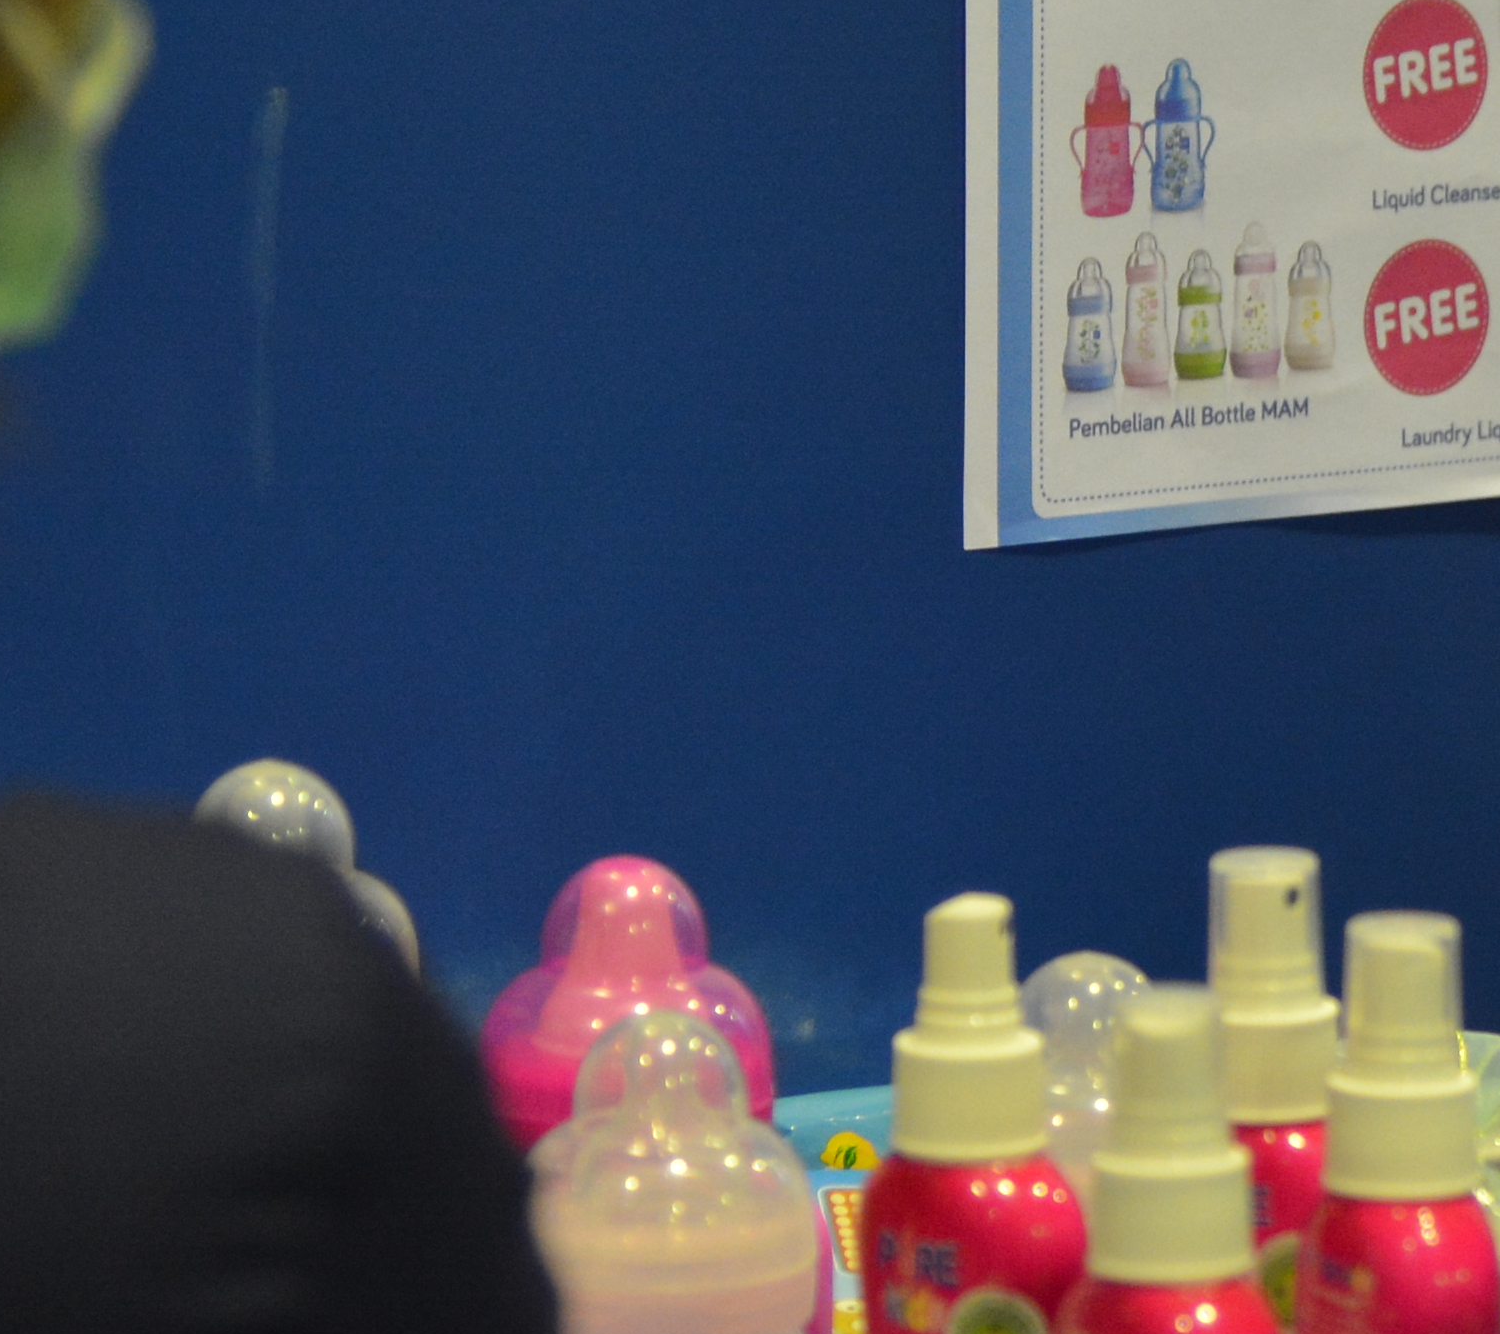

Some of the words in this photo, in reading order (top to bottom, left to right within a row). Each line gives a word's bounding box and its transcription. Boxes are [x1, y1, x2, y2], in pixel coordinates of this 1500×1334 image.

[1371, 37, 1479, 104] FREE
[1372, 184, 1426, 212] Liquid
[1373, 283, 1479, 350] FREE
[1069, 412, 1165, 440] Pembelian
[1170, 407, 1196, 430] All
[1201, 403, 1256, 427] Bottle
[1261, 397, 1310, 421] MAM
[1401, 421, 1472, 450] Laundry
